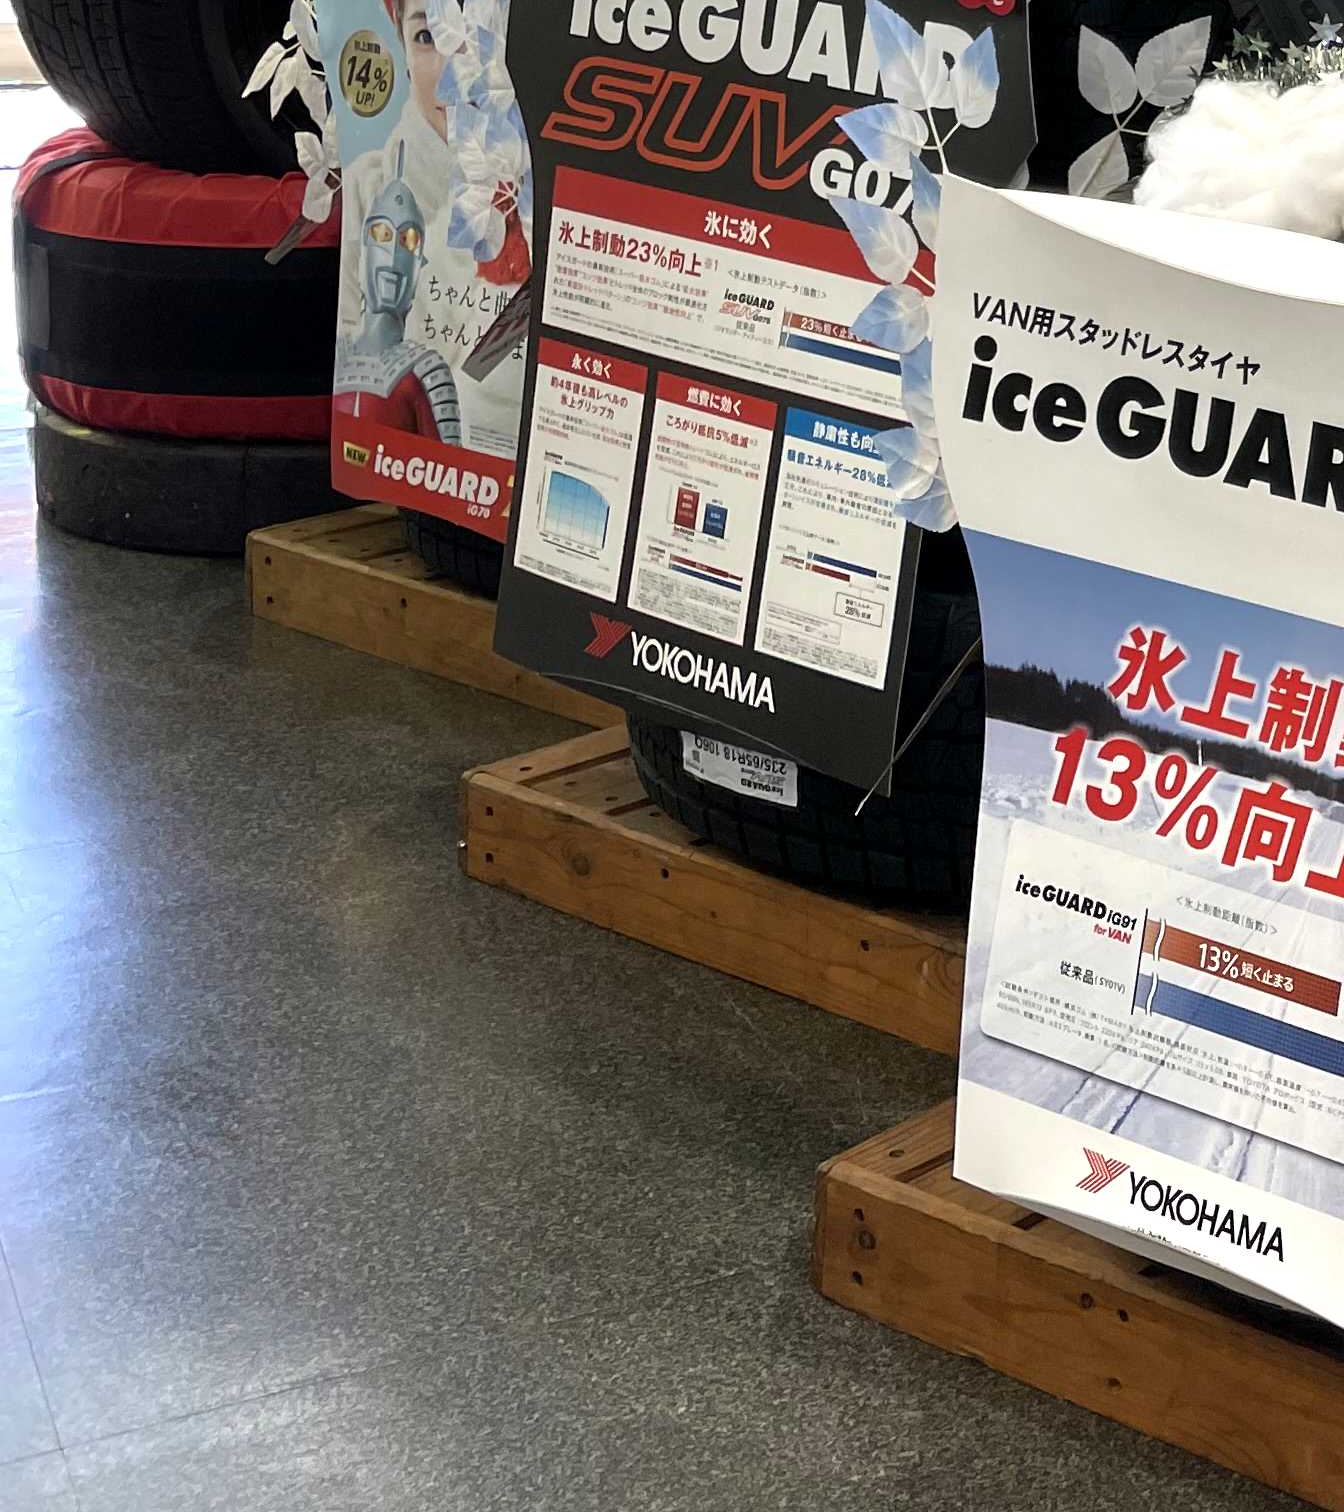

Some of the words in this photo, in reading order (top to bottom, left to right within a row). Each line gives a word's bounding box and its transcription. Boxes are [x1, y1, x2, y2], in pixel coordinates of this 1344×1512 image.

[344, 63, 389, 89] 14%
[353, 90, 376, 108] UP!
[541, 55, 863, 189] SUV
[703, 211, 772, 249] 氷に効く
[571, 353, 614, 378] 永く効く
[560, 396, 615, 421] 氷上グリップ力
[687, 389, 742, 415] 燃費に効く
[344, 445, 368, 462] NEW
[630, 631, 776, 713] YOKOHAMA
[1106, 908, 1137, 931] iG91
[1107, 928, 1132, 945] VAN
[1128, 1173, 1286, 1262] YOKOHAMA
